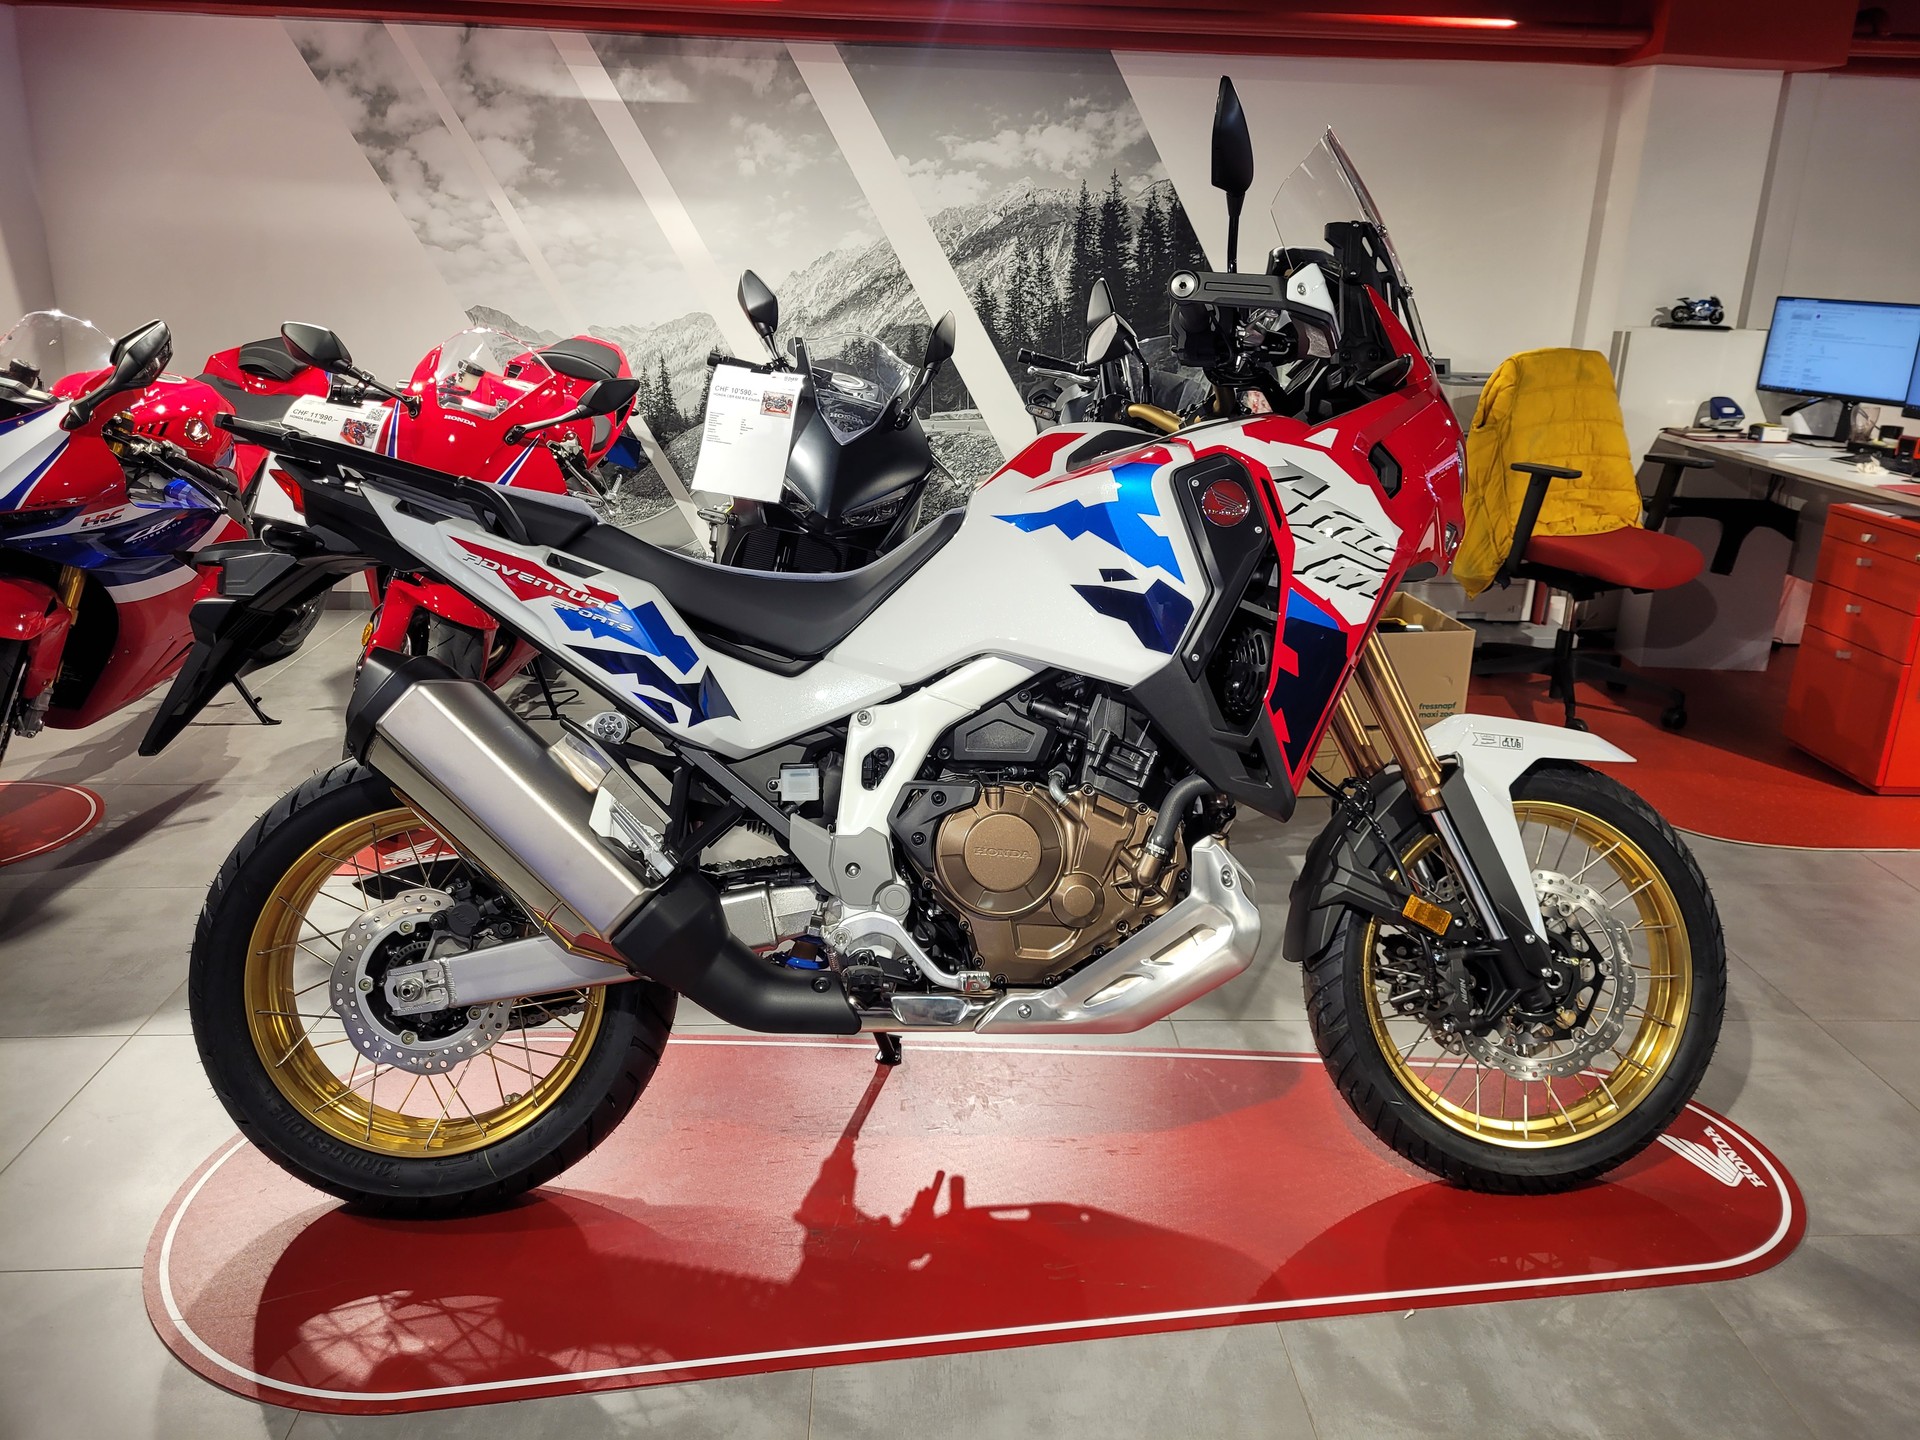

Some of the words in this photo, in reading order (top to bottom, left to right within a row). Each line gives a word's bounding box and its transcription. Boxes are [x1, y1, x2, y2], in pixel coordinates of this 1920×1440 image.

[293, 408, 308, 416] CHF
[829, 412, 865, 425] HONDA
[443, 414, 477, 428] HONDA
[80, 507, 125, 527] HRC
[463, 553, 623, 615] ADVENTURE
[550, 600, 635, 632] SPORTS
[1418, 701, 1457, 711] fressnapf
[1418, 710, 1439, 718] maxi
[974, 846, 1033, 861] HONDA
[1703, 1126, 1768, 1188] HONDA
